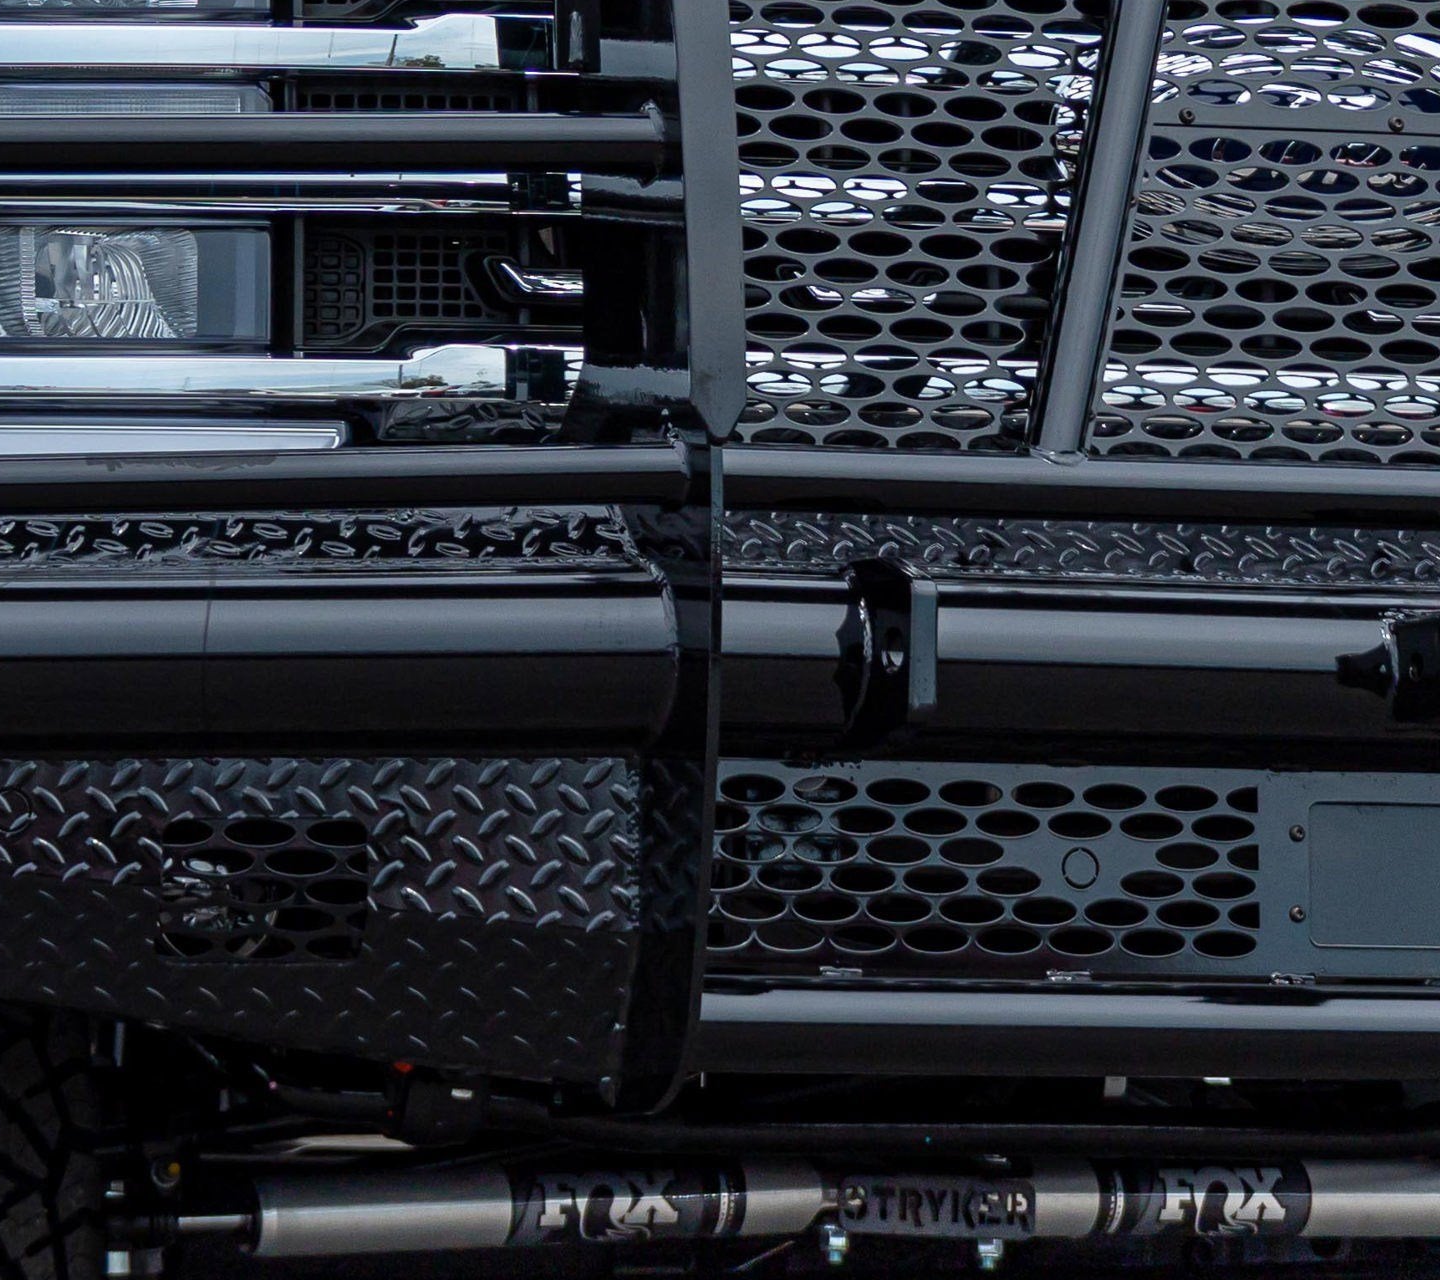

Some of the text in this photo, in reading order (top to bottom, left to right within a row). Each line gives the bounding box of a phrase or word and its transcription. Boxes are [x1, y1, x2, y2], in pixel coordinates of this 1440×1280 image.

[535, 1167, 680, 1243] FOX
[842, 1182, 1035, 1235] STRYKER
[1156, 1166, 1288, 1238] FOX
